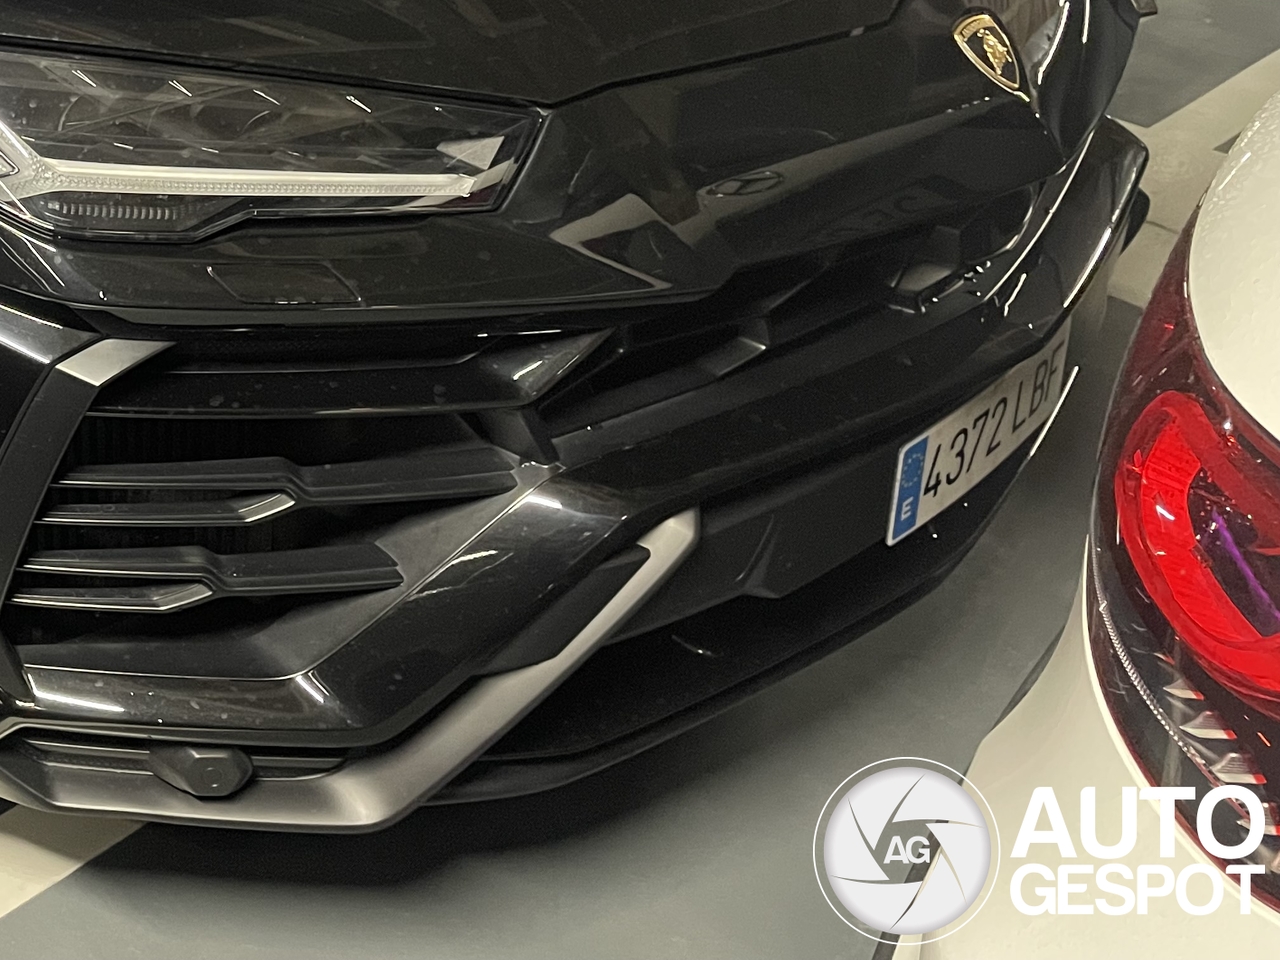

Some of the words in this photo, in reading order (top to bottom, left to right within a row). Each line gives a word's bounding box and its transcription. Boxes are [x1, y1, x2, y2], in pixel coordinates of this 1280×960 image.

[923, 396, 1008, 498] 4372
[1012, 339, 1065, 434] LBF
[901, 496, 914, 520] E
